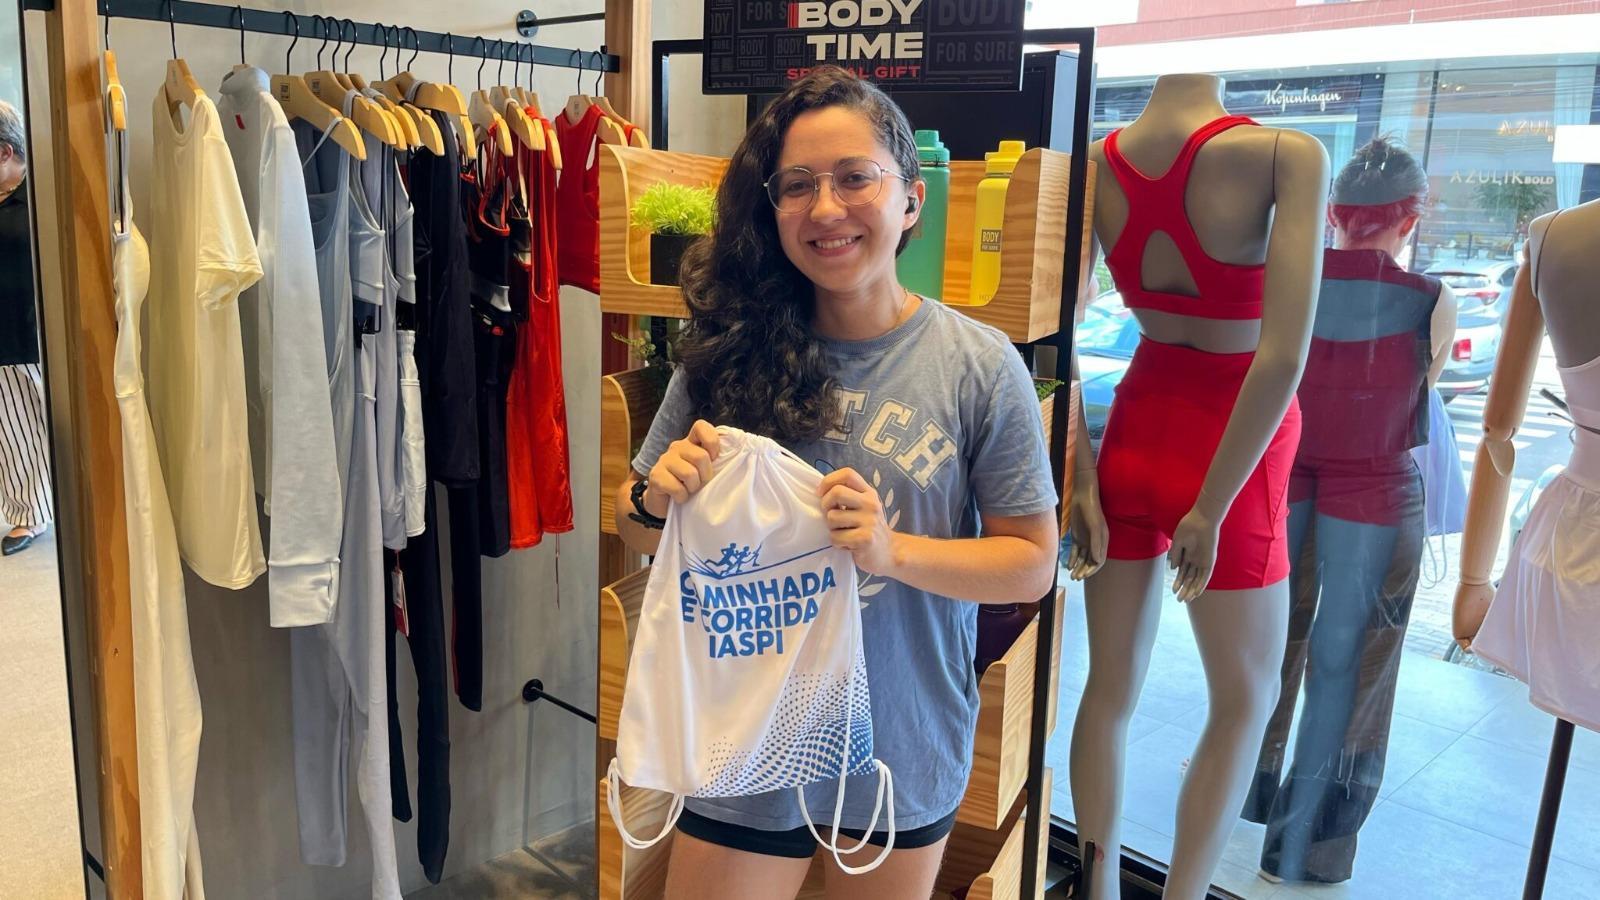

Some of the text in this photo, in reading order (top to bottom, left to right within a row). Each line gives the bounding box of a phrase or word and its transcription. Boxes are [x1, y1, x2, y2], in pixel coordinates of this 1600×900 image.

[798, 0, 924, 28] BODY
[807, 32, 923, 60] TIME
[936, 41, 1015, 63] FOR SURE
[786, 64, 921, 80] SPAL GIFT
[1264, 83, 1342, 112] Kopenhagen
[1499, 120, 1554, 134] AZUL
[983, 231, 1000, 242] BODY
[820, 387, 957, 493] TCH
[680, 566, 836, 608] CMINHADA
[680, 596, 698, 623] E
[709, 629, 784, 659] IASPI
